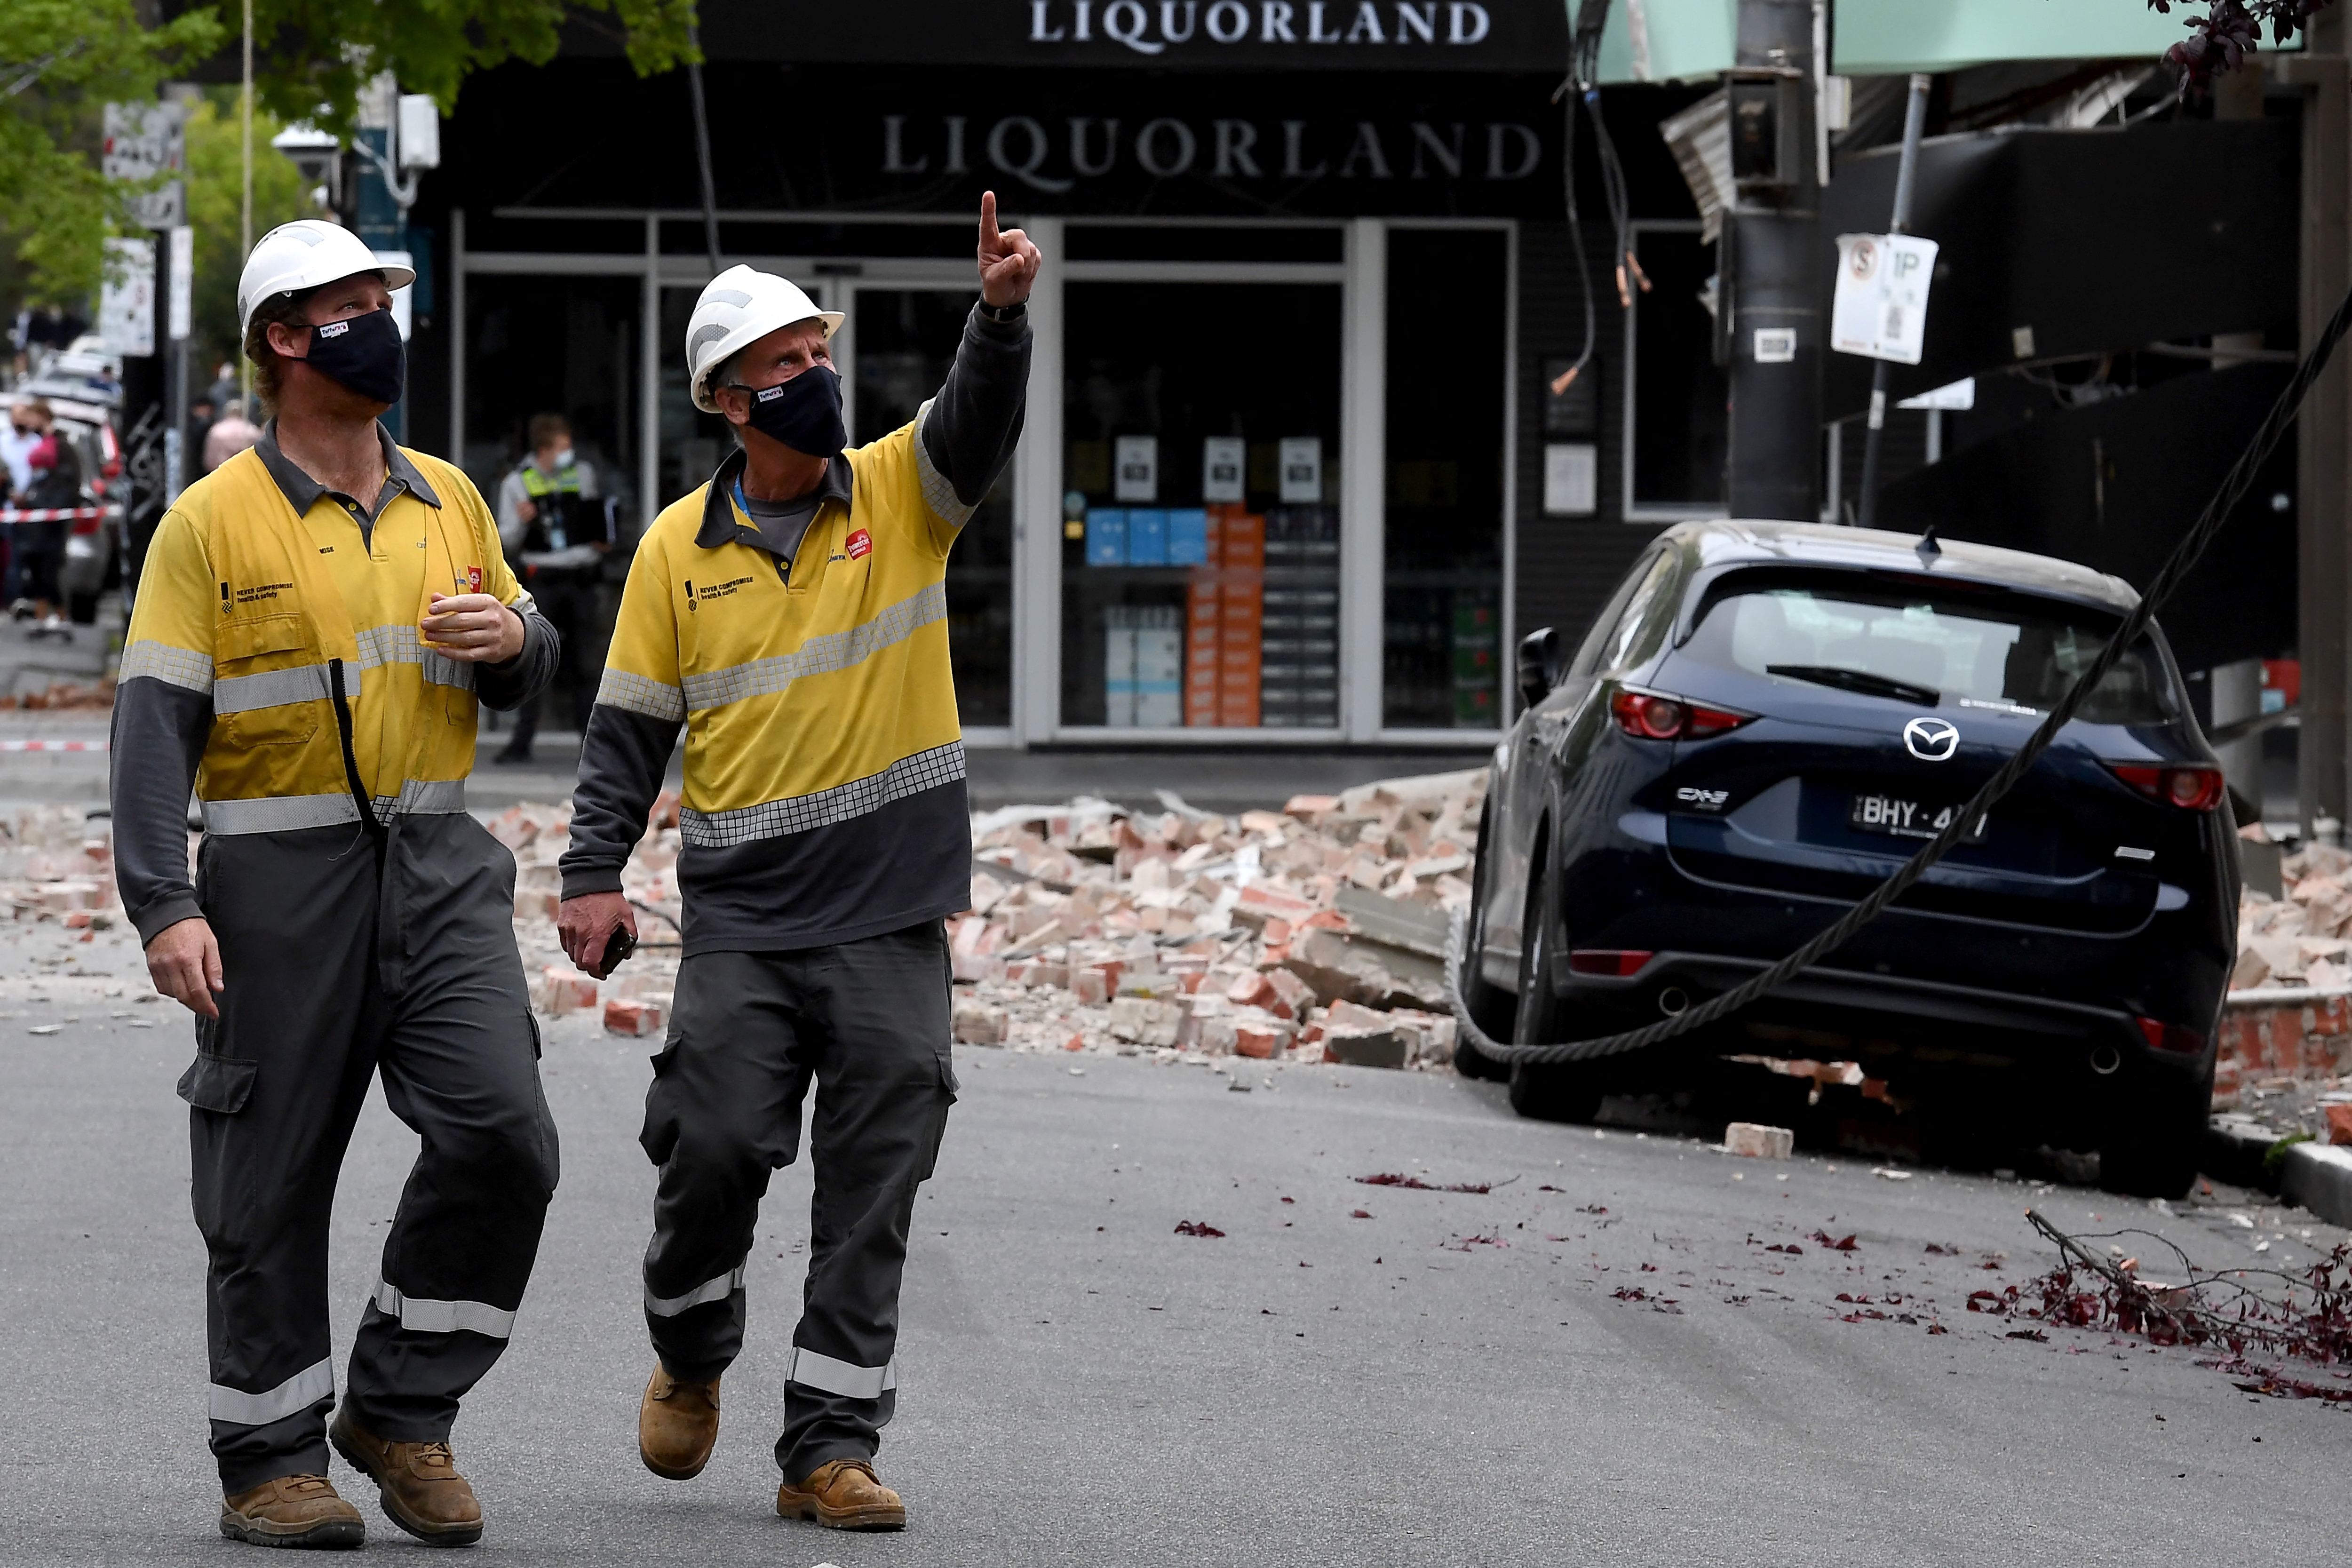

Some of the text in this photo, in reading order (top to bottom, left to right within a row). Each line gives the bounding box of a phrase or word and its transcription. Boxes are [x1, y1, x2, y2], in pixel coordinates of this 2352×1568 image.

[1028, 0, 1490, 55] LIQUORLAND
[882, 115, 1542, 192] LIQUORLAND
[256, 583, 293, 593] COMPROMISE
[700, 576, 754, 594] NEVER COMPROMISE
[722, 587, 737, 596] safety
